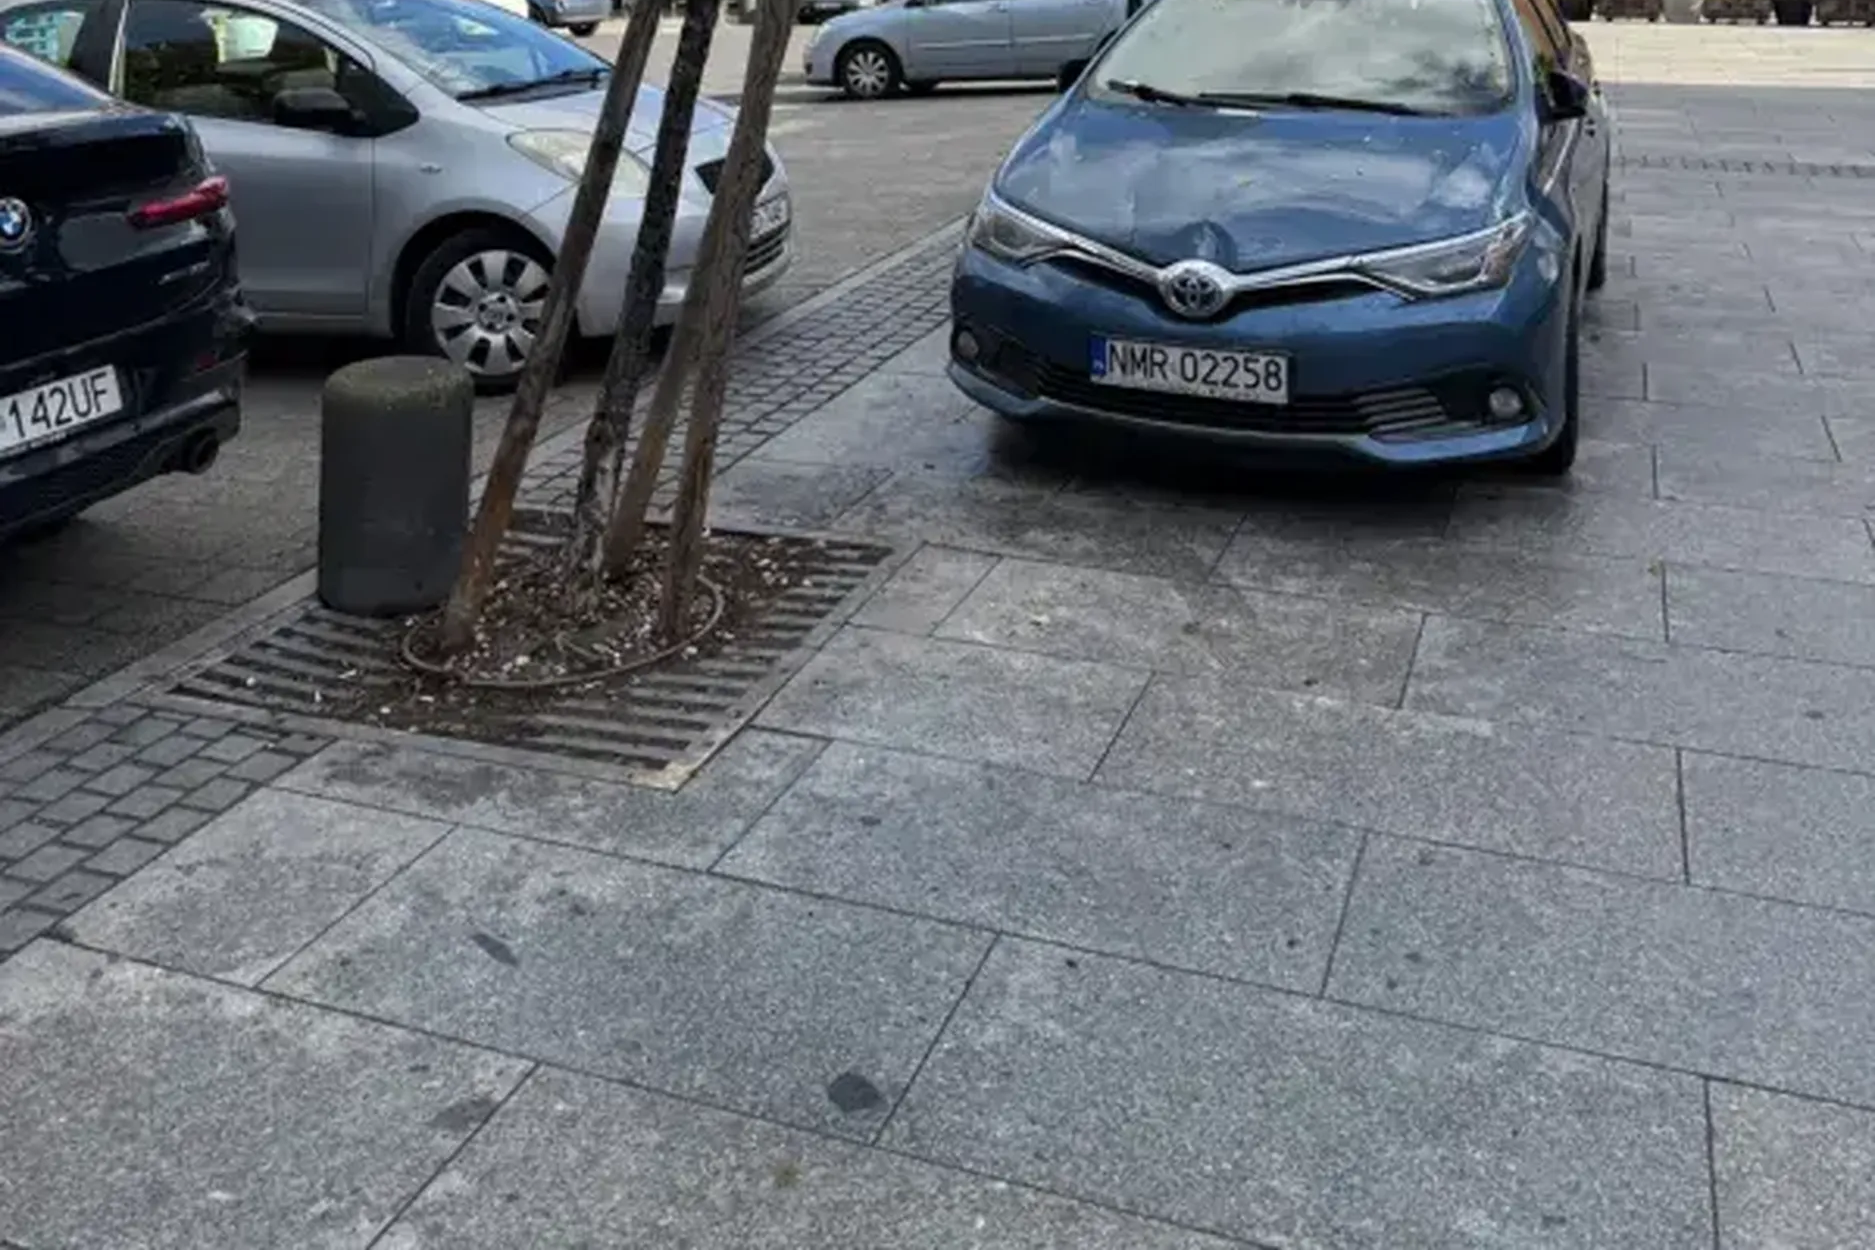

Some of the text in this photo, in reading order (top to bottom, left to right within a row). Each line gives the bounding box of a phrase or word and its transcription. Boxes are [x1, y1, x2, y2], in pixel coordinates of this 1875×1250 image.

[1109, 343, 1282, 392] NMR 02258
[8, 371, 108, 439] 142UF
